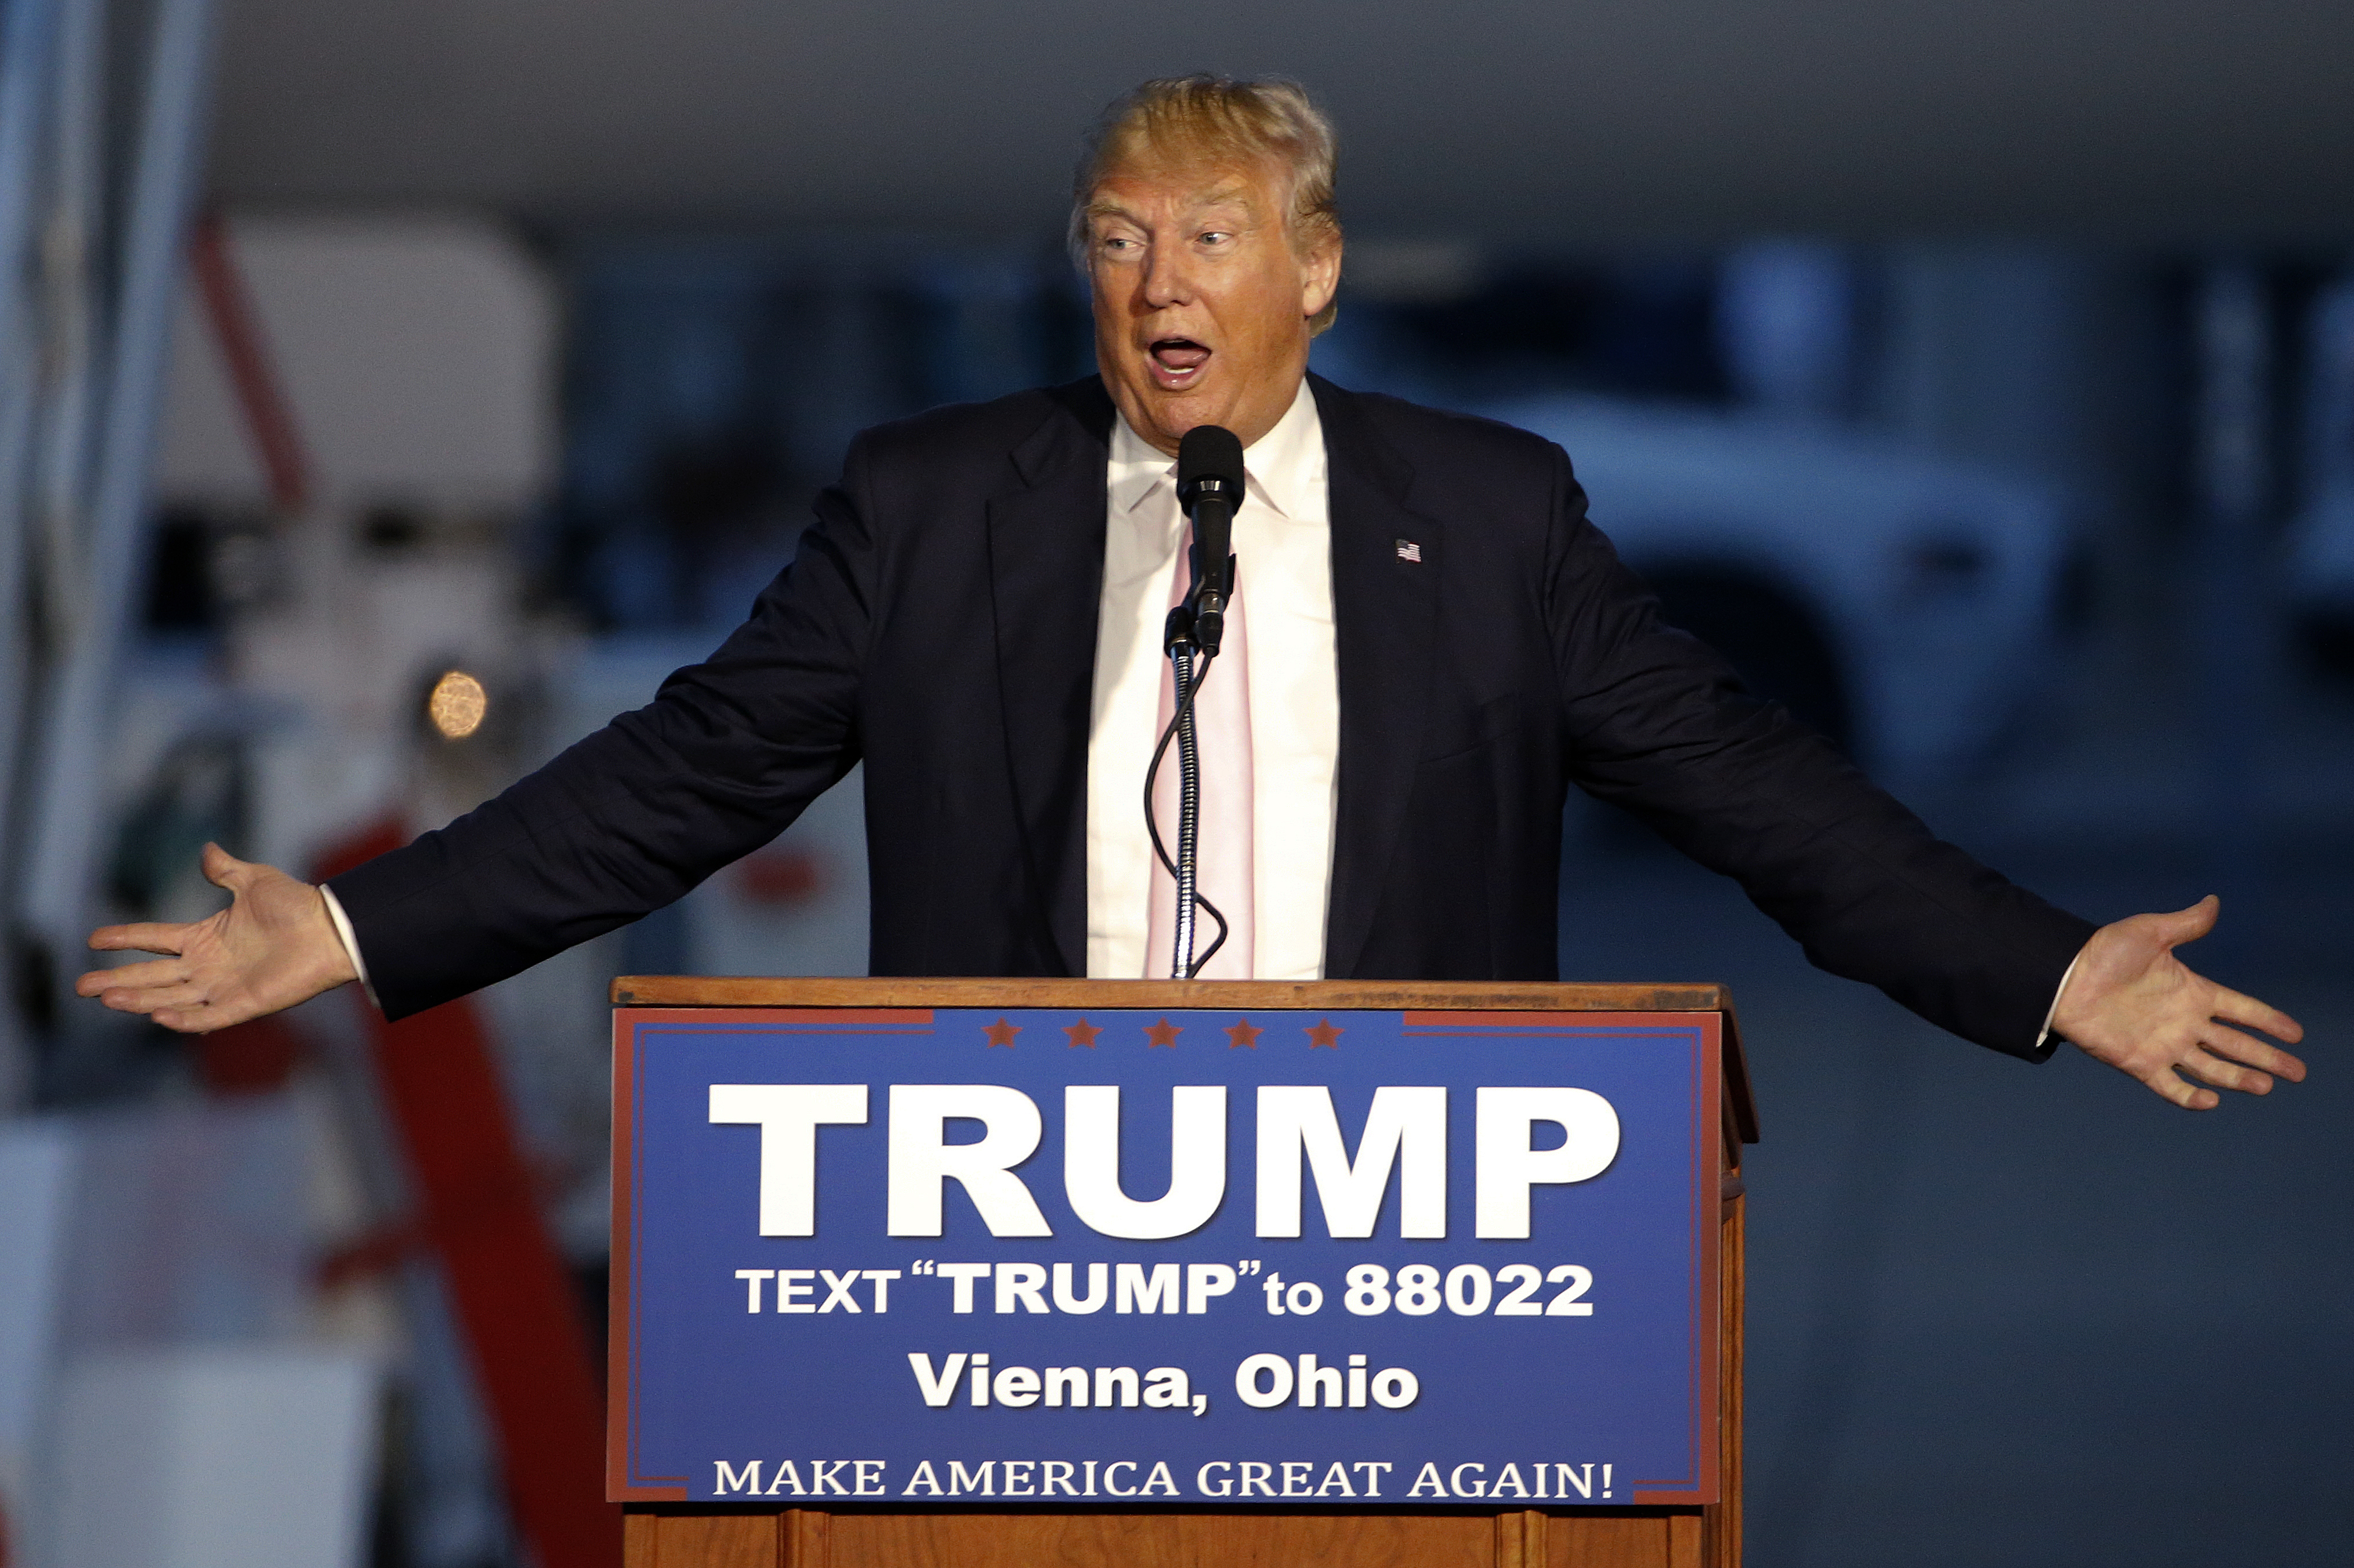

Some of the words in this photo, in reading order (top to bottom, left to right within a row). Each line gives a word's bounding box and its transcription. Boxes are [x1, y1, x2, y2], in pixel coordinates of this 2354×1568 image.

[708, 1084, 1620, 1239] TRUMP
[734, 1269, 902, 1314] TEXT
[1262, 1272, 1324, 1316] to
[1343, 1263, 1594, 1317] 88022
[907, 1352, 1207, 1417] Vienna,
[1235, 1353, 1419, 1408] Ohio
[712, 1460, 886, 1496] MAKE
[901, 1460, 1181, 1497] AMERICA
[1197, 1461, 1392, 1497] GREAT
[1406, 1462, 1613, 1499] AGAIN!
